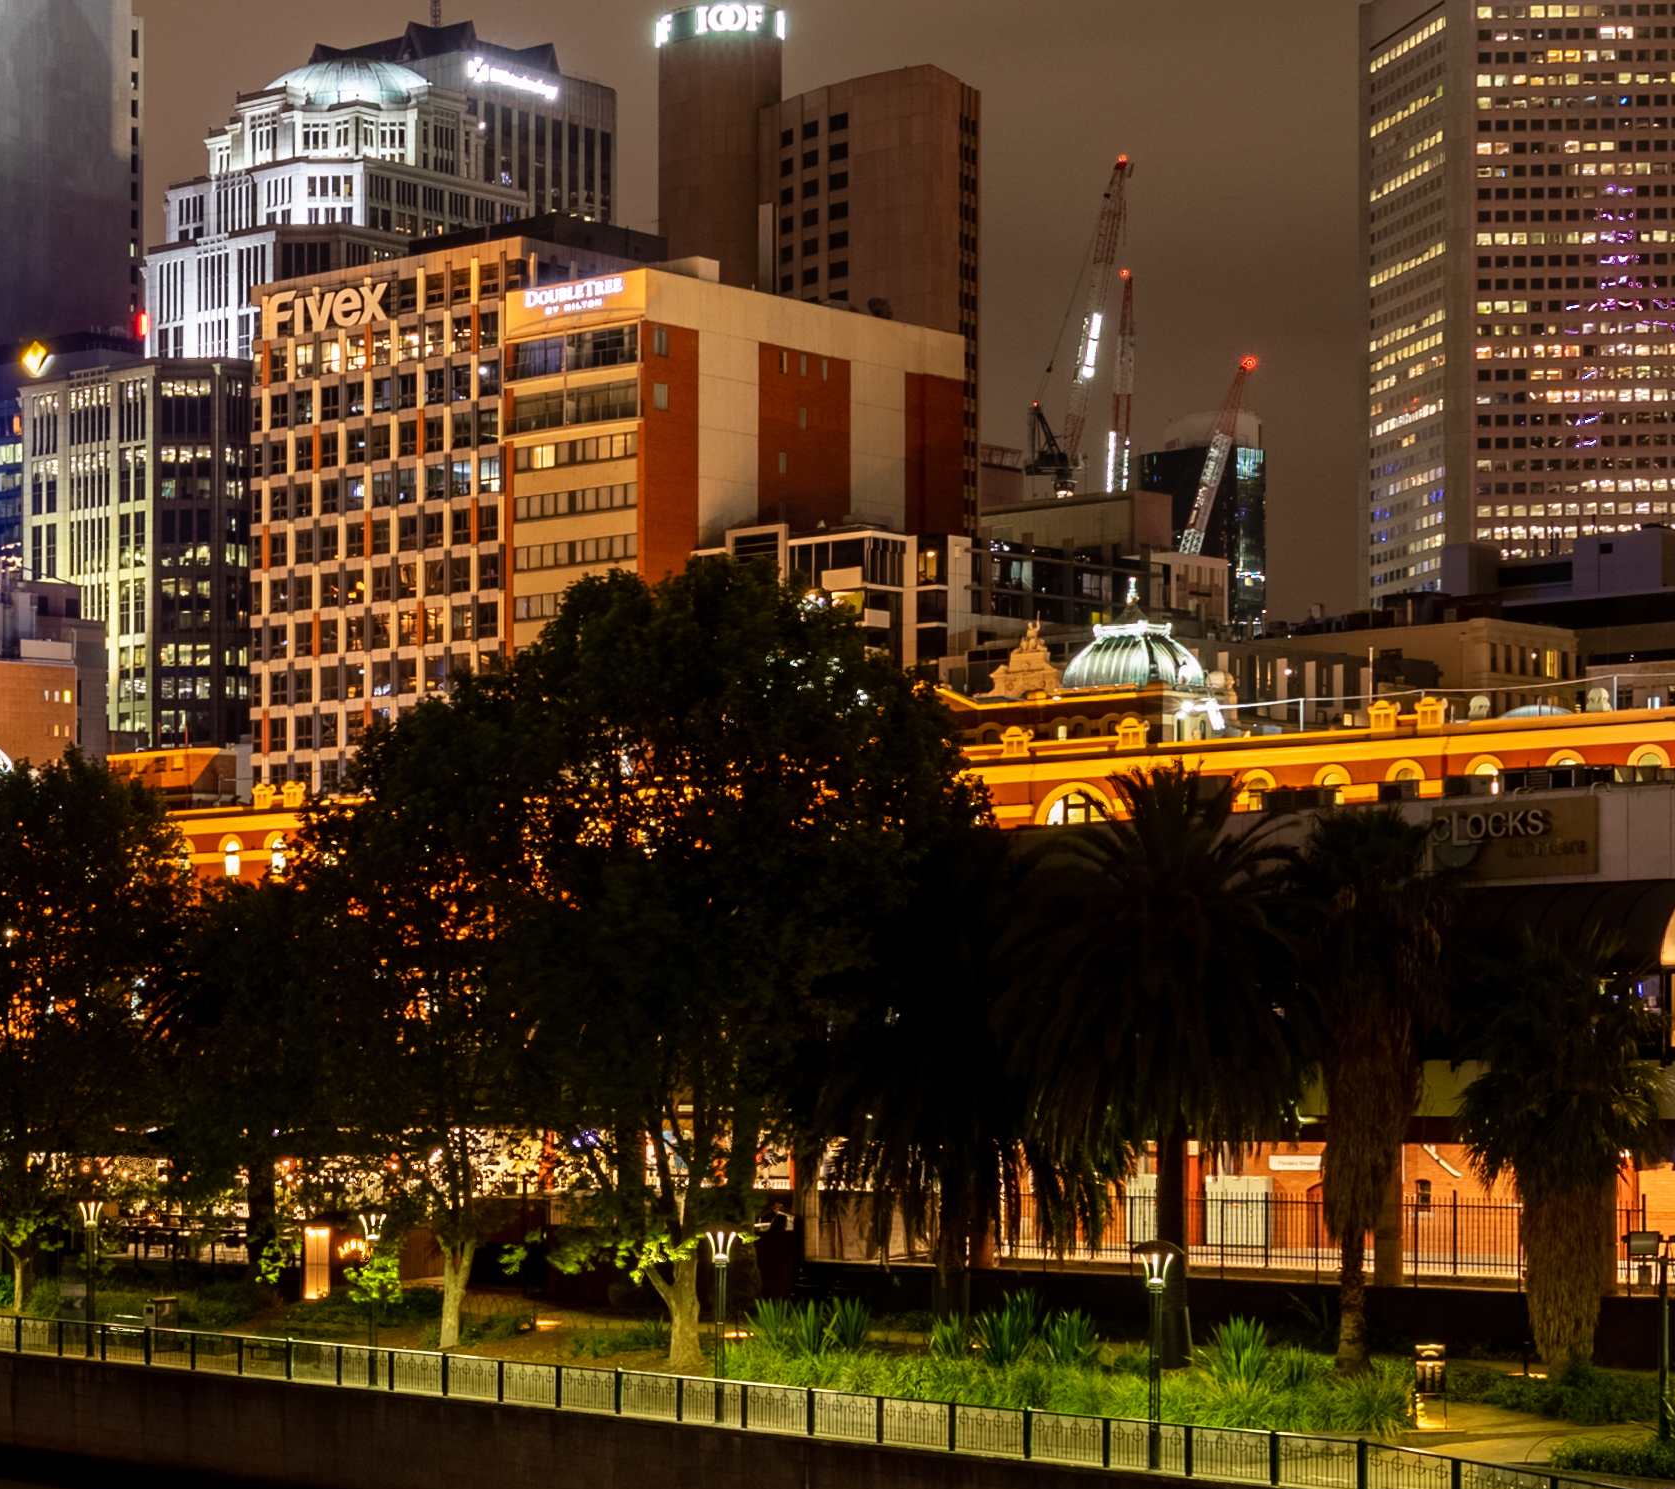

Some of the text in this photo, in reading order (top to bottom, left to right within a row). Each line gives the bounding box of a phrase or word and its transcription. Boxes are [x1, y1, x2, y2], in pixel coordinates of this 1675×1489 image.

[695, 4, 764, 34] IOOF
[268, 282, 389, 340] Fivex
[563, 298, 602, 311] HILTON
[1432, 809, 1544, 846] CLOCKS
